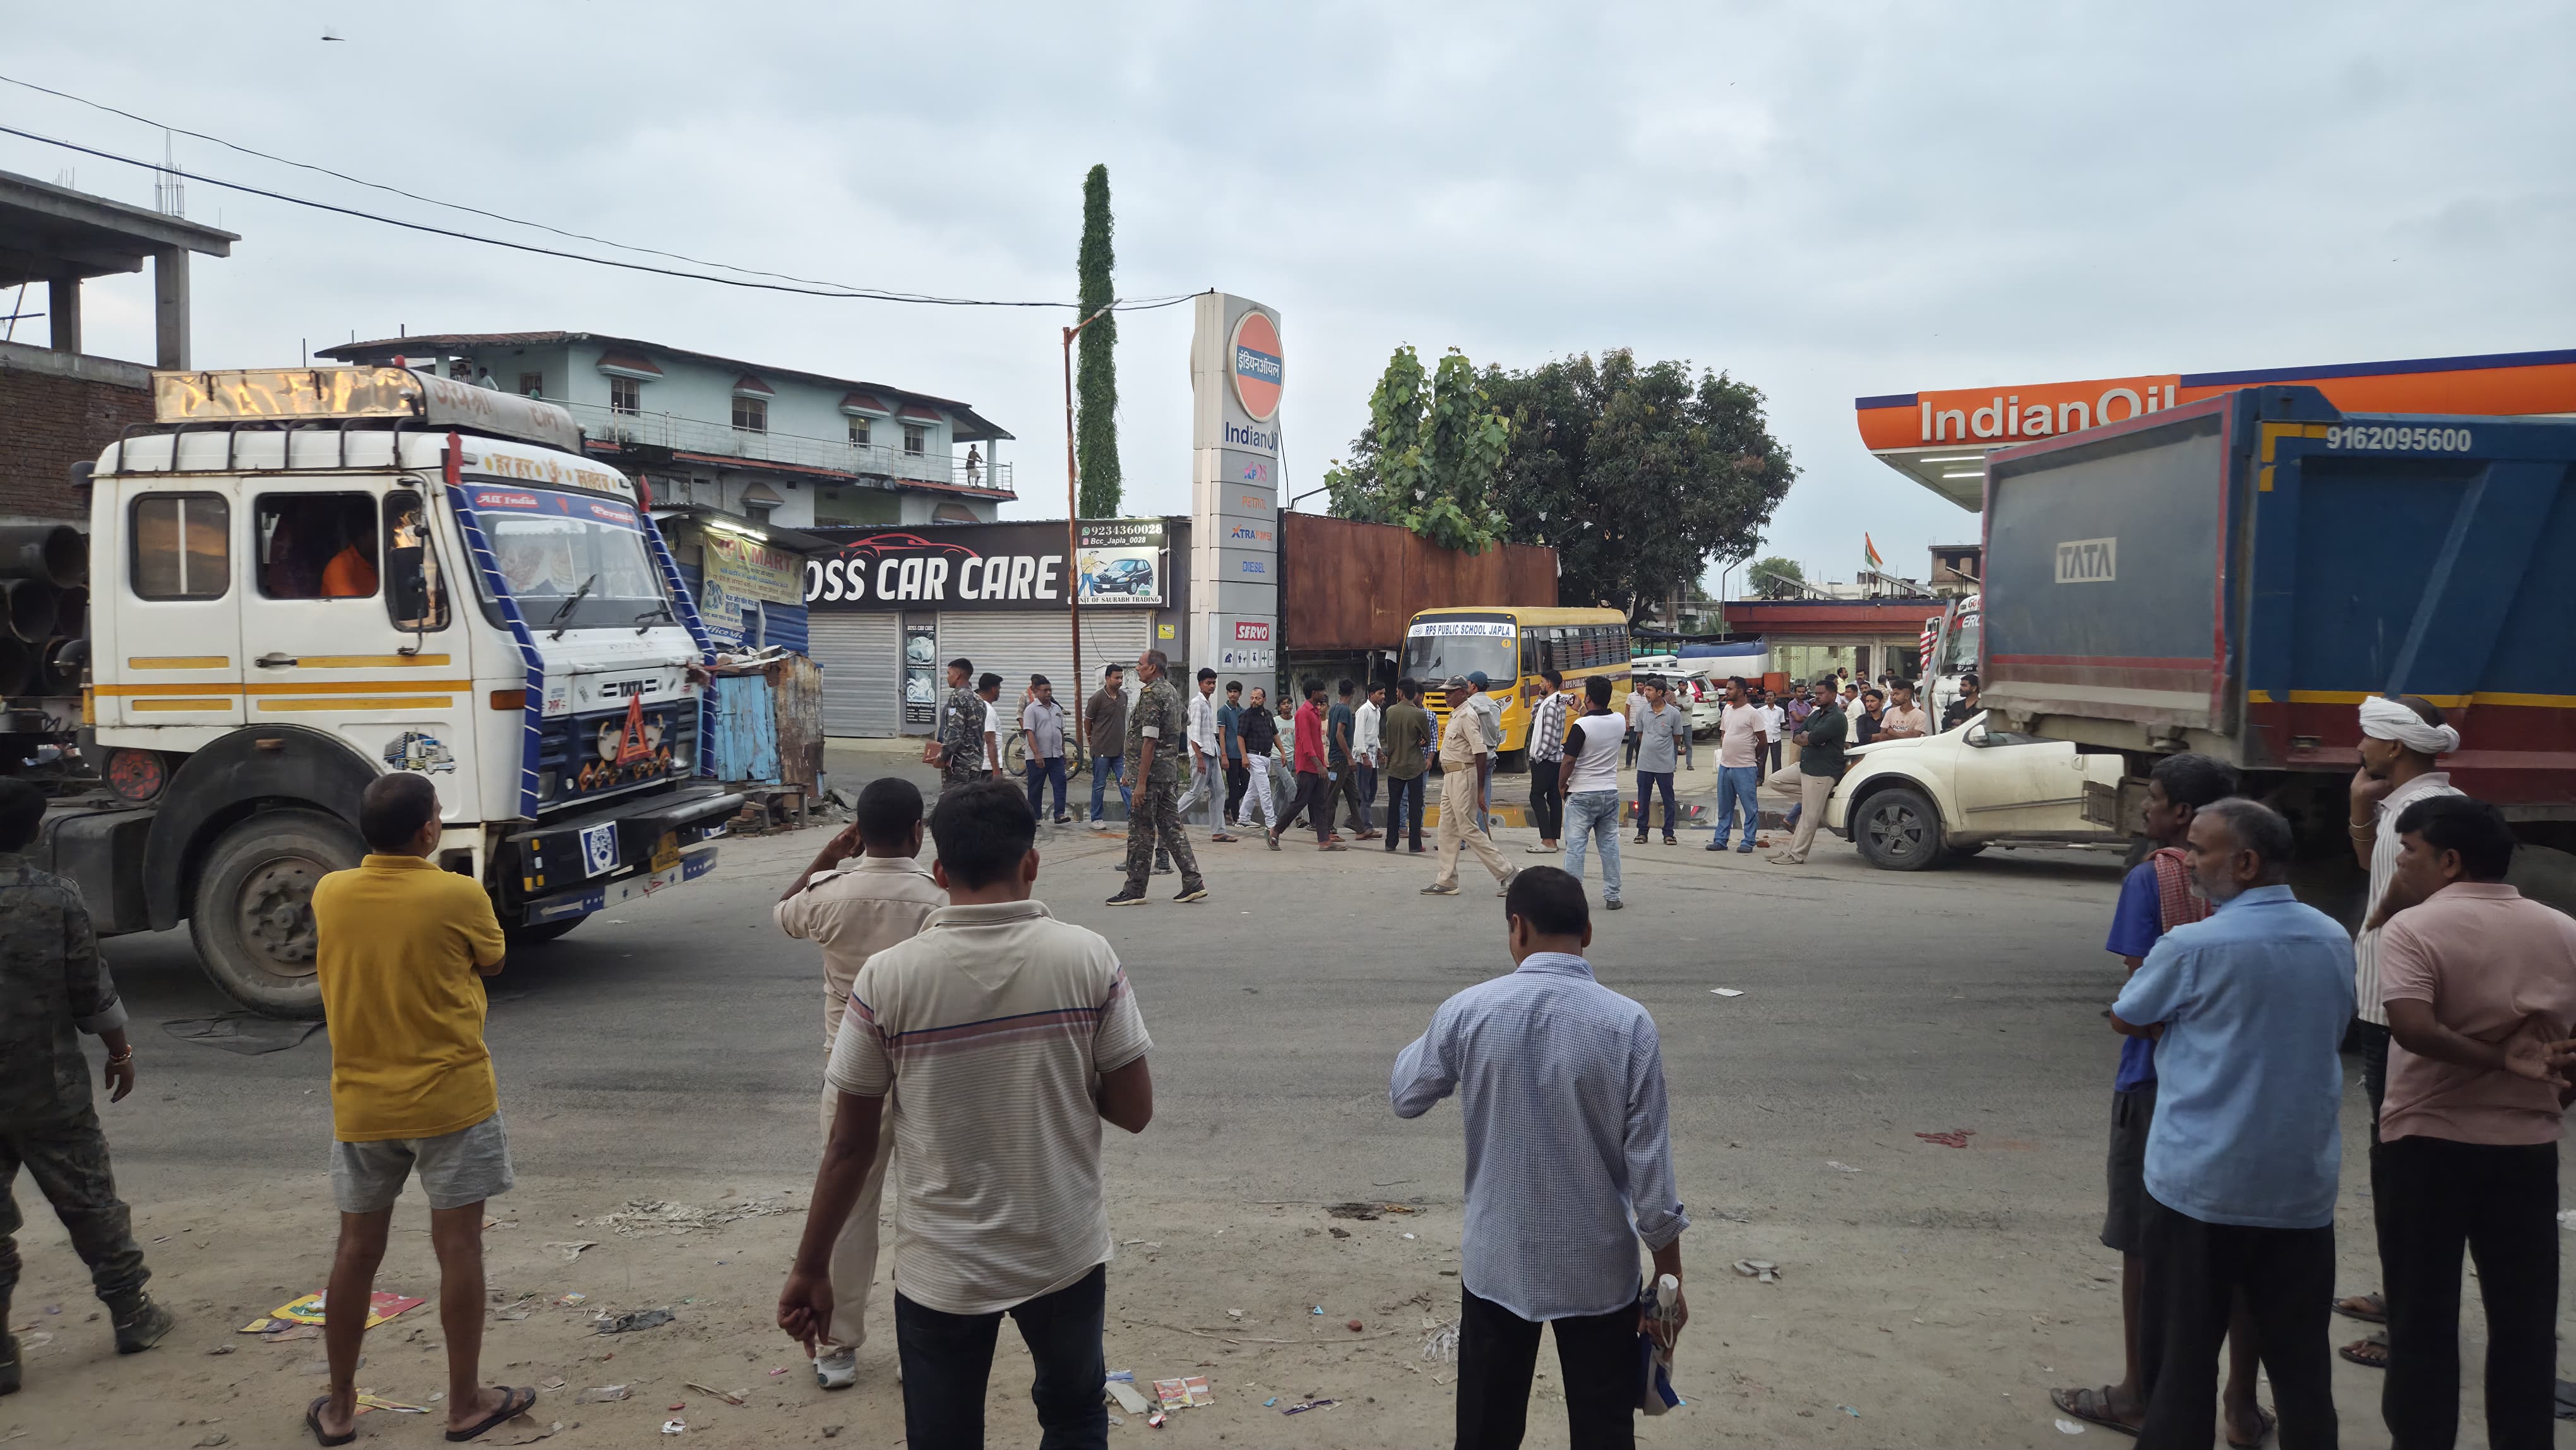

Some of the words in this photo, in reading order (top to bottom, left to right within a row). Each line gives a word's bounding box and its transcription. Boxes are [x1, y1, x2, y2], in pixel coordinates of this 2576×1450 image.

[1238, 350, 1280, 378] इंडियनऑयल
[1922, 385, 2175, 441] IndianOil
[1225, 421, 1278, 452] IndianOil
[2326, 426, 2472, 452] 9162095600
[1243, 496, 1267, 510] PETROL
[1090, 536, 1147, 546] Bcc_Japla_0028
[1092, 524, 1163, 536] 9234360028
[751, 546, 793, 573] MART
[1243, 561, 1265, 573] DIESEL
[2060, 543, 2113, 578] TATA
[807, 559, 866, 602] OSS
[876, 558, 949, 601] CAR
[959, 555, 1063, 600] CARE
[1237, 625, 1268, 639] SERVO
[1425, 625, 1436, 635] RPS
[1438, 625, 1459, 635] PUBLIC
[1460, 625, 1486, 635] SCHOOL
[1489, 626, 1510, 636] JAPLA
[619, 680, 644, 698] TATA
